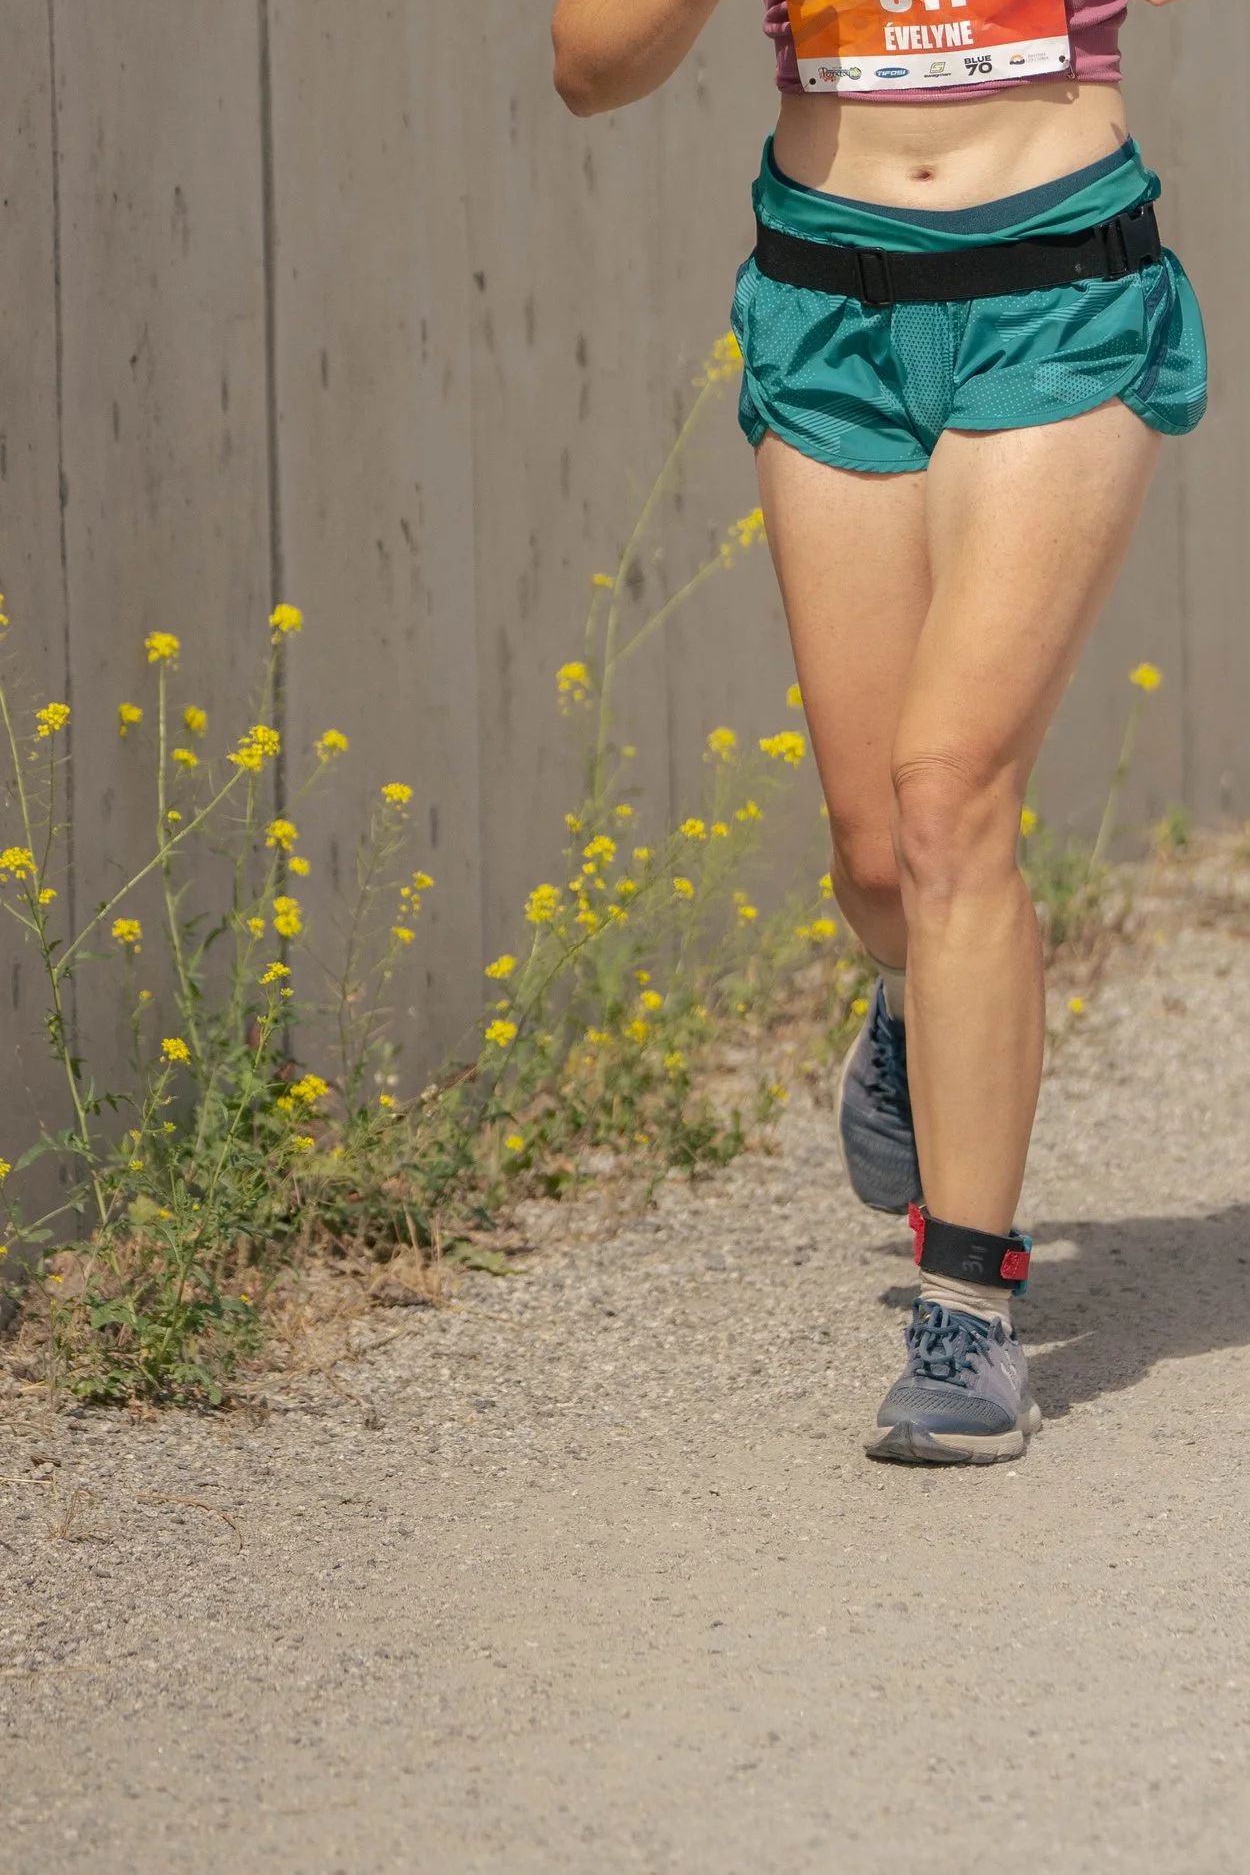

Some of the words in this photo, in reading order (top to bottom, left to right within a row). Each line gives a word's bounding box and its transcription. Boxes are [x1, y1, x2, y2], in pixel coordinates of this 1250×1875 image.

[884, 20, 974, 51] ÉVELYNE
[964, 55, 992, 65] BLUE
[876, 69, 907, 77] TIFOSI
[965, 62, 993, 76] 70
